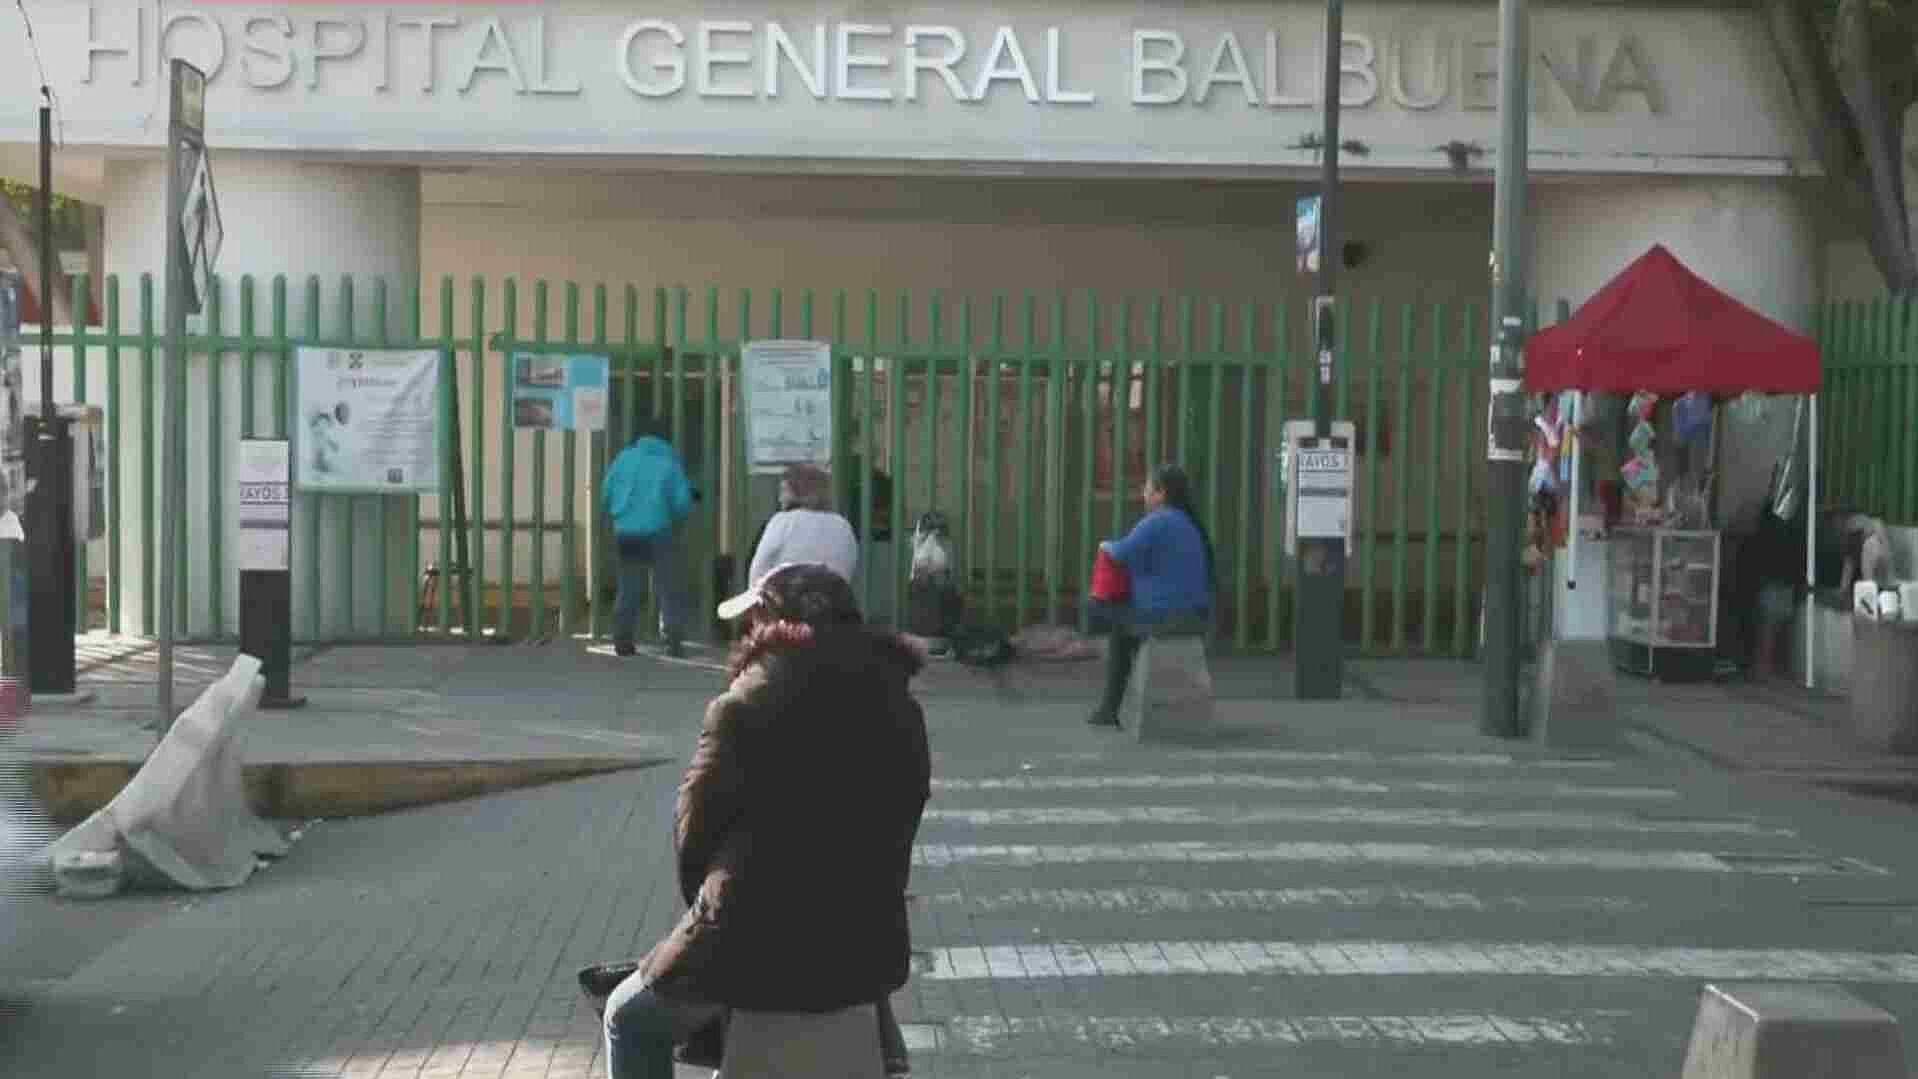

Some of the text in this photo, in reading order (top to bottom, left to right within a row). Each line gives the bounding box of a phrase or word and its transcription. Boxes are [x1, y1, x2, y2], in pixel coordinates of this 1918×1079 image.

[80, 7, 1666, 115] HOSPITAL GENERAL BALBUENA
